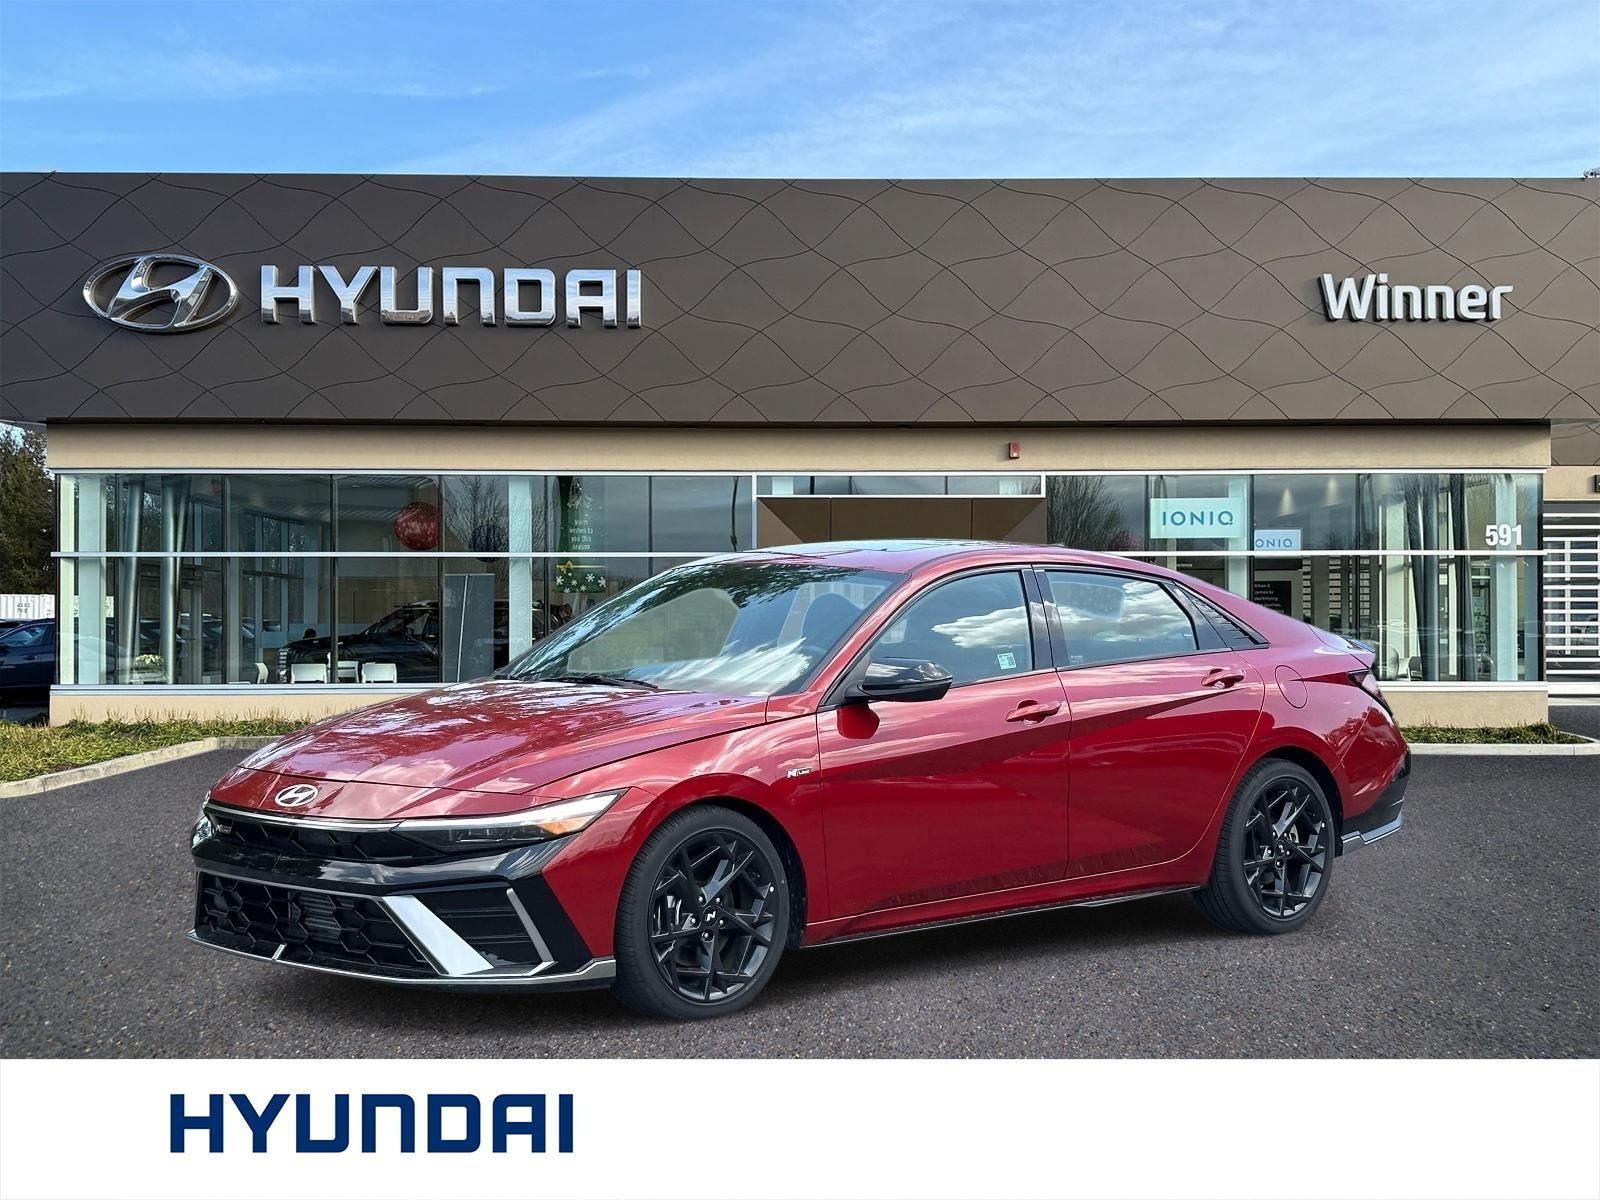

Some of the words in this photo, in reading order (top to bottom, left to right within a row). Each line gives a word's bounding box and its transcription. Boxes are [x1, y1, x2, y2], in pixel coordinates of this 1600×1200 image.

[260, 264, 643, 328] HYUNDAI
[1320, 272, 1514, 322] Winner
[1162, 510, 1234, 526] IONIQ
[1485, 523, 1523, 546] 591
